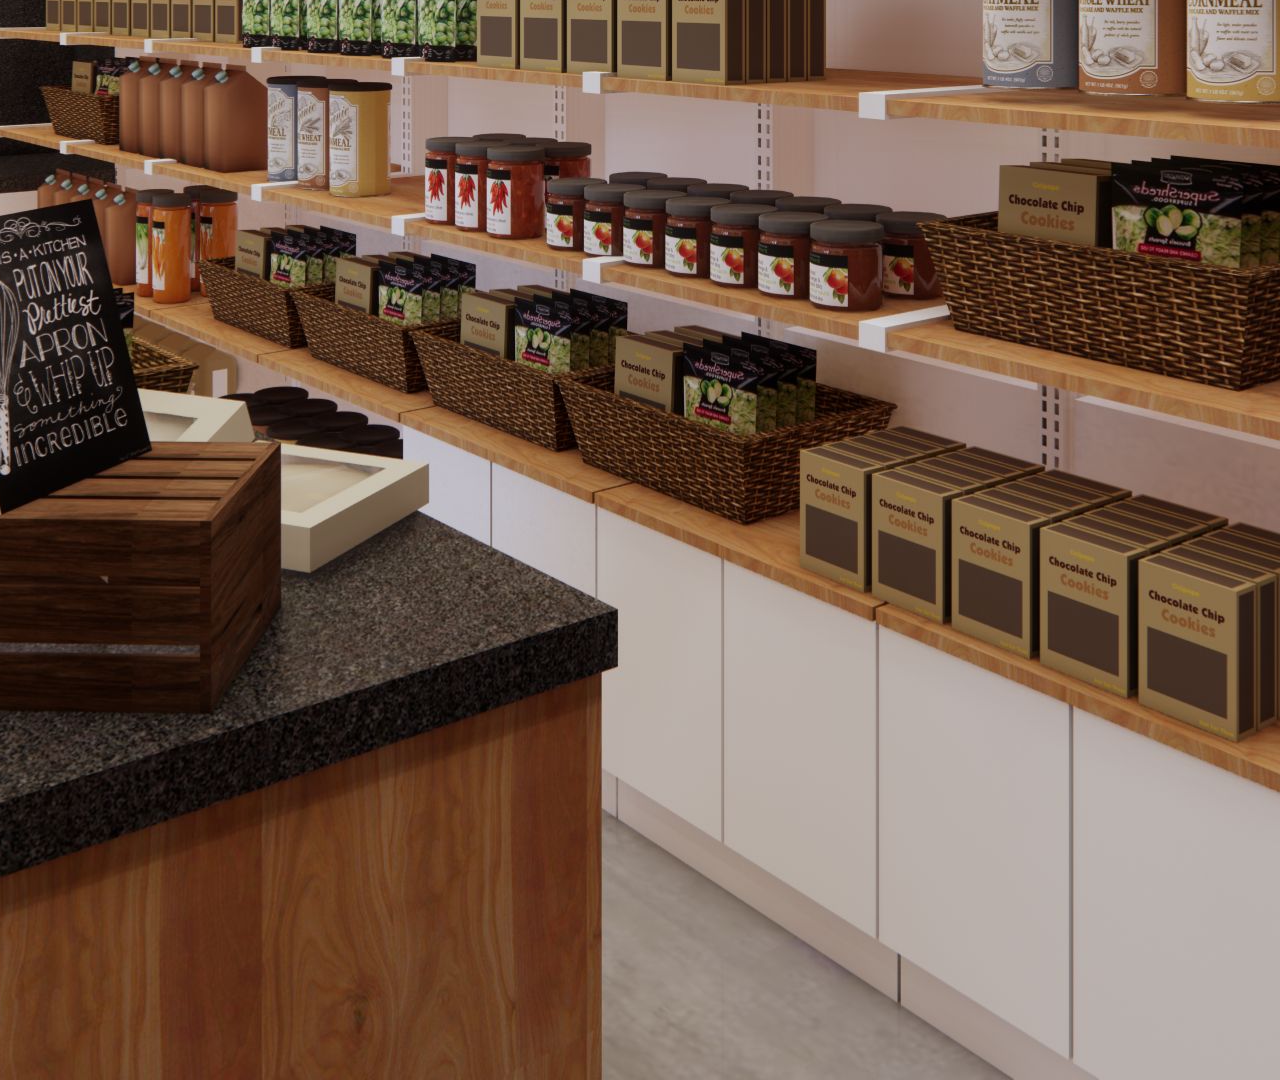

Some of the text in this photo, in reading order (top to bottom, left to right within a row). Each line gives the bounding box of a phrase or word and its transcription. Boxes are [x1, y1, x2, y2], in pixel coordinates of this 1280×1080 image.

[485, 1, 508, 10] Cookies
[529, 2, 553, 11] Cookies
[577, 2, 603, 12] Cookies
[628, 3, 656, 14] Cookies
[684, 4, 714, 15] Cookies
[1009, 194, 1085, 215] Chocolate Chip
[1021, 210, 1075, 231] Cookies
[19, 248, 29, 260] A
[32, 234, 87, 257] KITCHEN
[13, 251, 94, 302] PUT ON YOUR
[22, 290, 102, 335] Prettiest
[465, 313, 500, 331] Chocolate Chip
[20, 318, 109, 368] APRON
[28, 354, 86, 407] WHIP
[87, 346, 115, 388] UP
[621, 359, 666, 381] Chocolate Chip
[628, 374, 660, 393] Cookies
[13, 386, 123, 439] something
[806, 473, 857, 498] Chocolate Chip
[815, 489, 851, 510] Cookies
[879, 498, 935, 525] Chocolate Chip
[888, 513, 928, 537] Cookies
[959, 526, 1021, 555] Chocolate Chip
[970, 542, 1013, 567] Cookies
[1049, 556, 1117, 588] Chocolate Chip
[1060, 573, 1110, 601] Cookies
[1149, 590, 1199, 615] Chocolate
[1201, 607, 1225, 624] Chip
[1161, 608, 1217, 638] Cookies
